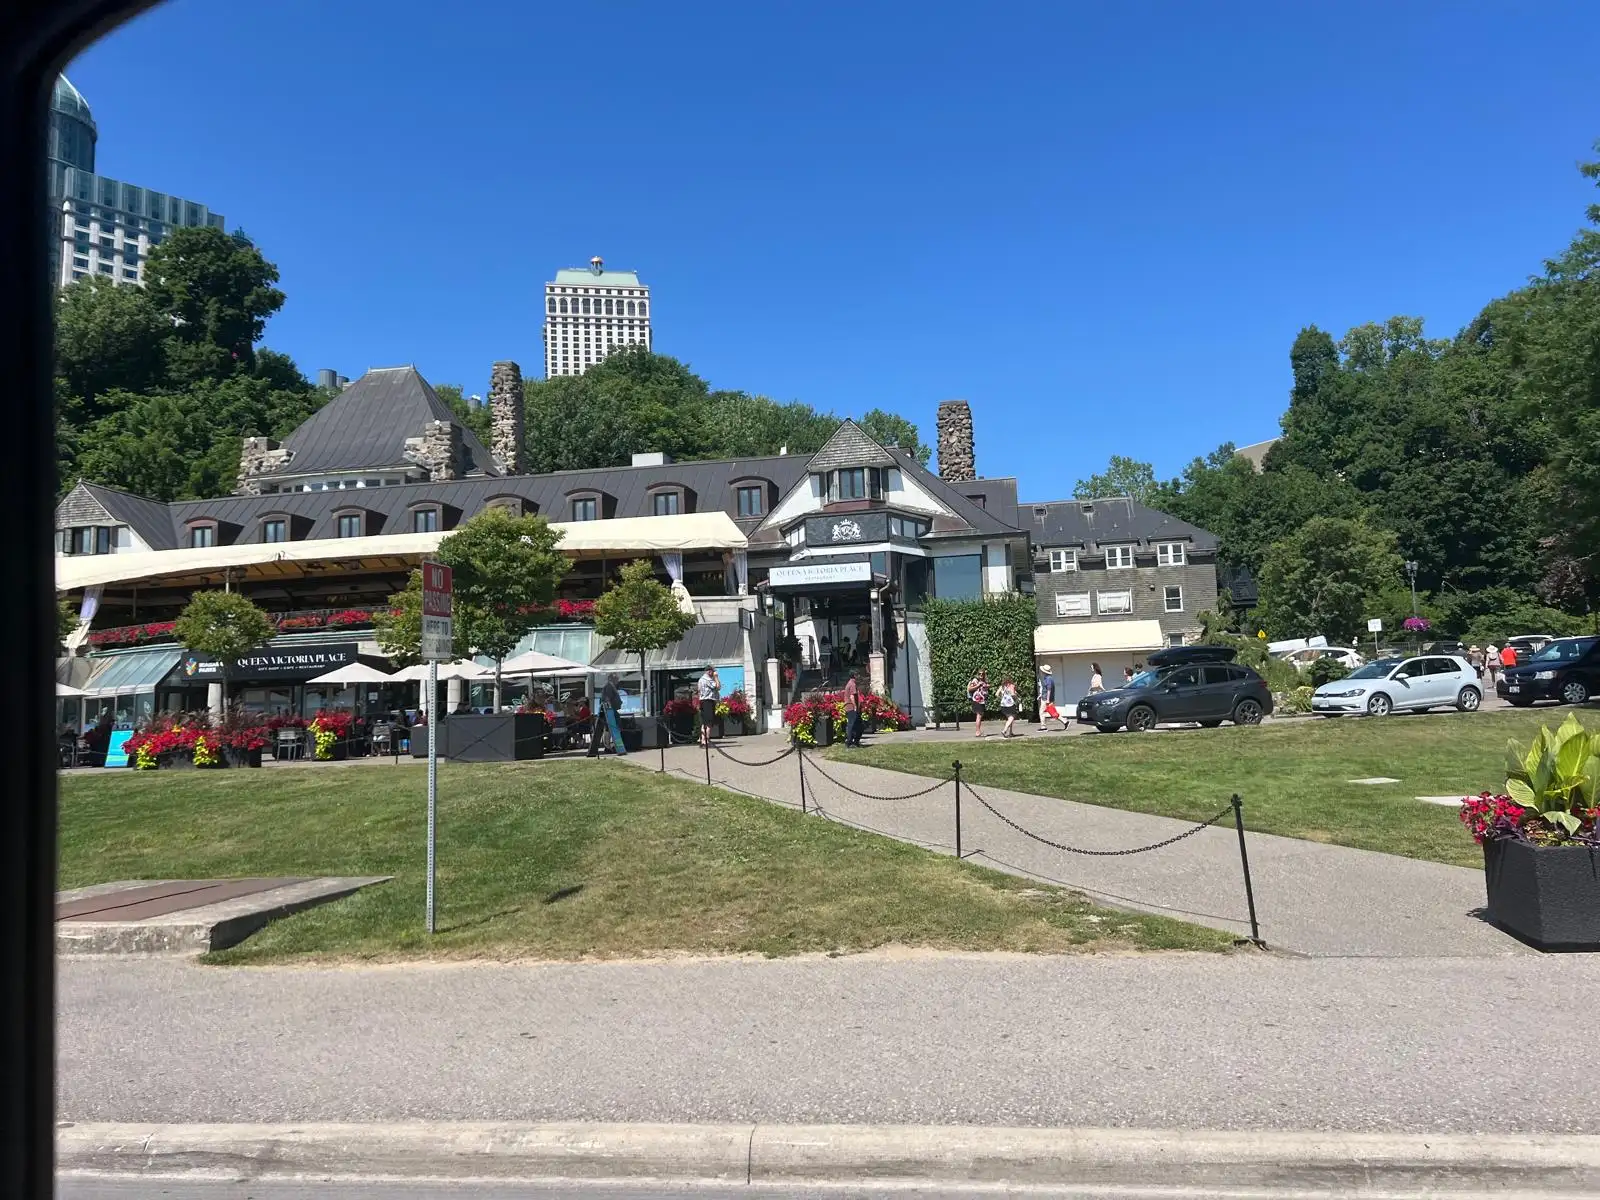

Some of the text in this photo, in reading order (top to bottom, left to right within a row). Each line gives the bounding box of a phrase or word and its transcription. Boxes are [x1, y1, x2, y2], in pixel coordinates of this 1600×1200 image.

[432, 567, 444, 589] NO
[776, 565, 865, 577] QUEEN VICTORIA PLACE
[424, 589, 451, 613] PASSING
[441, 621, 449, 636] TO
[237, 652, 347, 668] QUEEN VICTORIA PLACE
